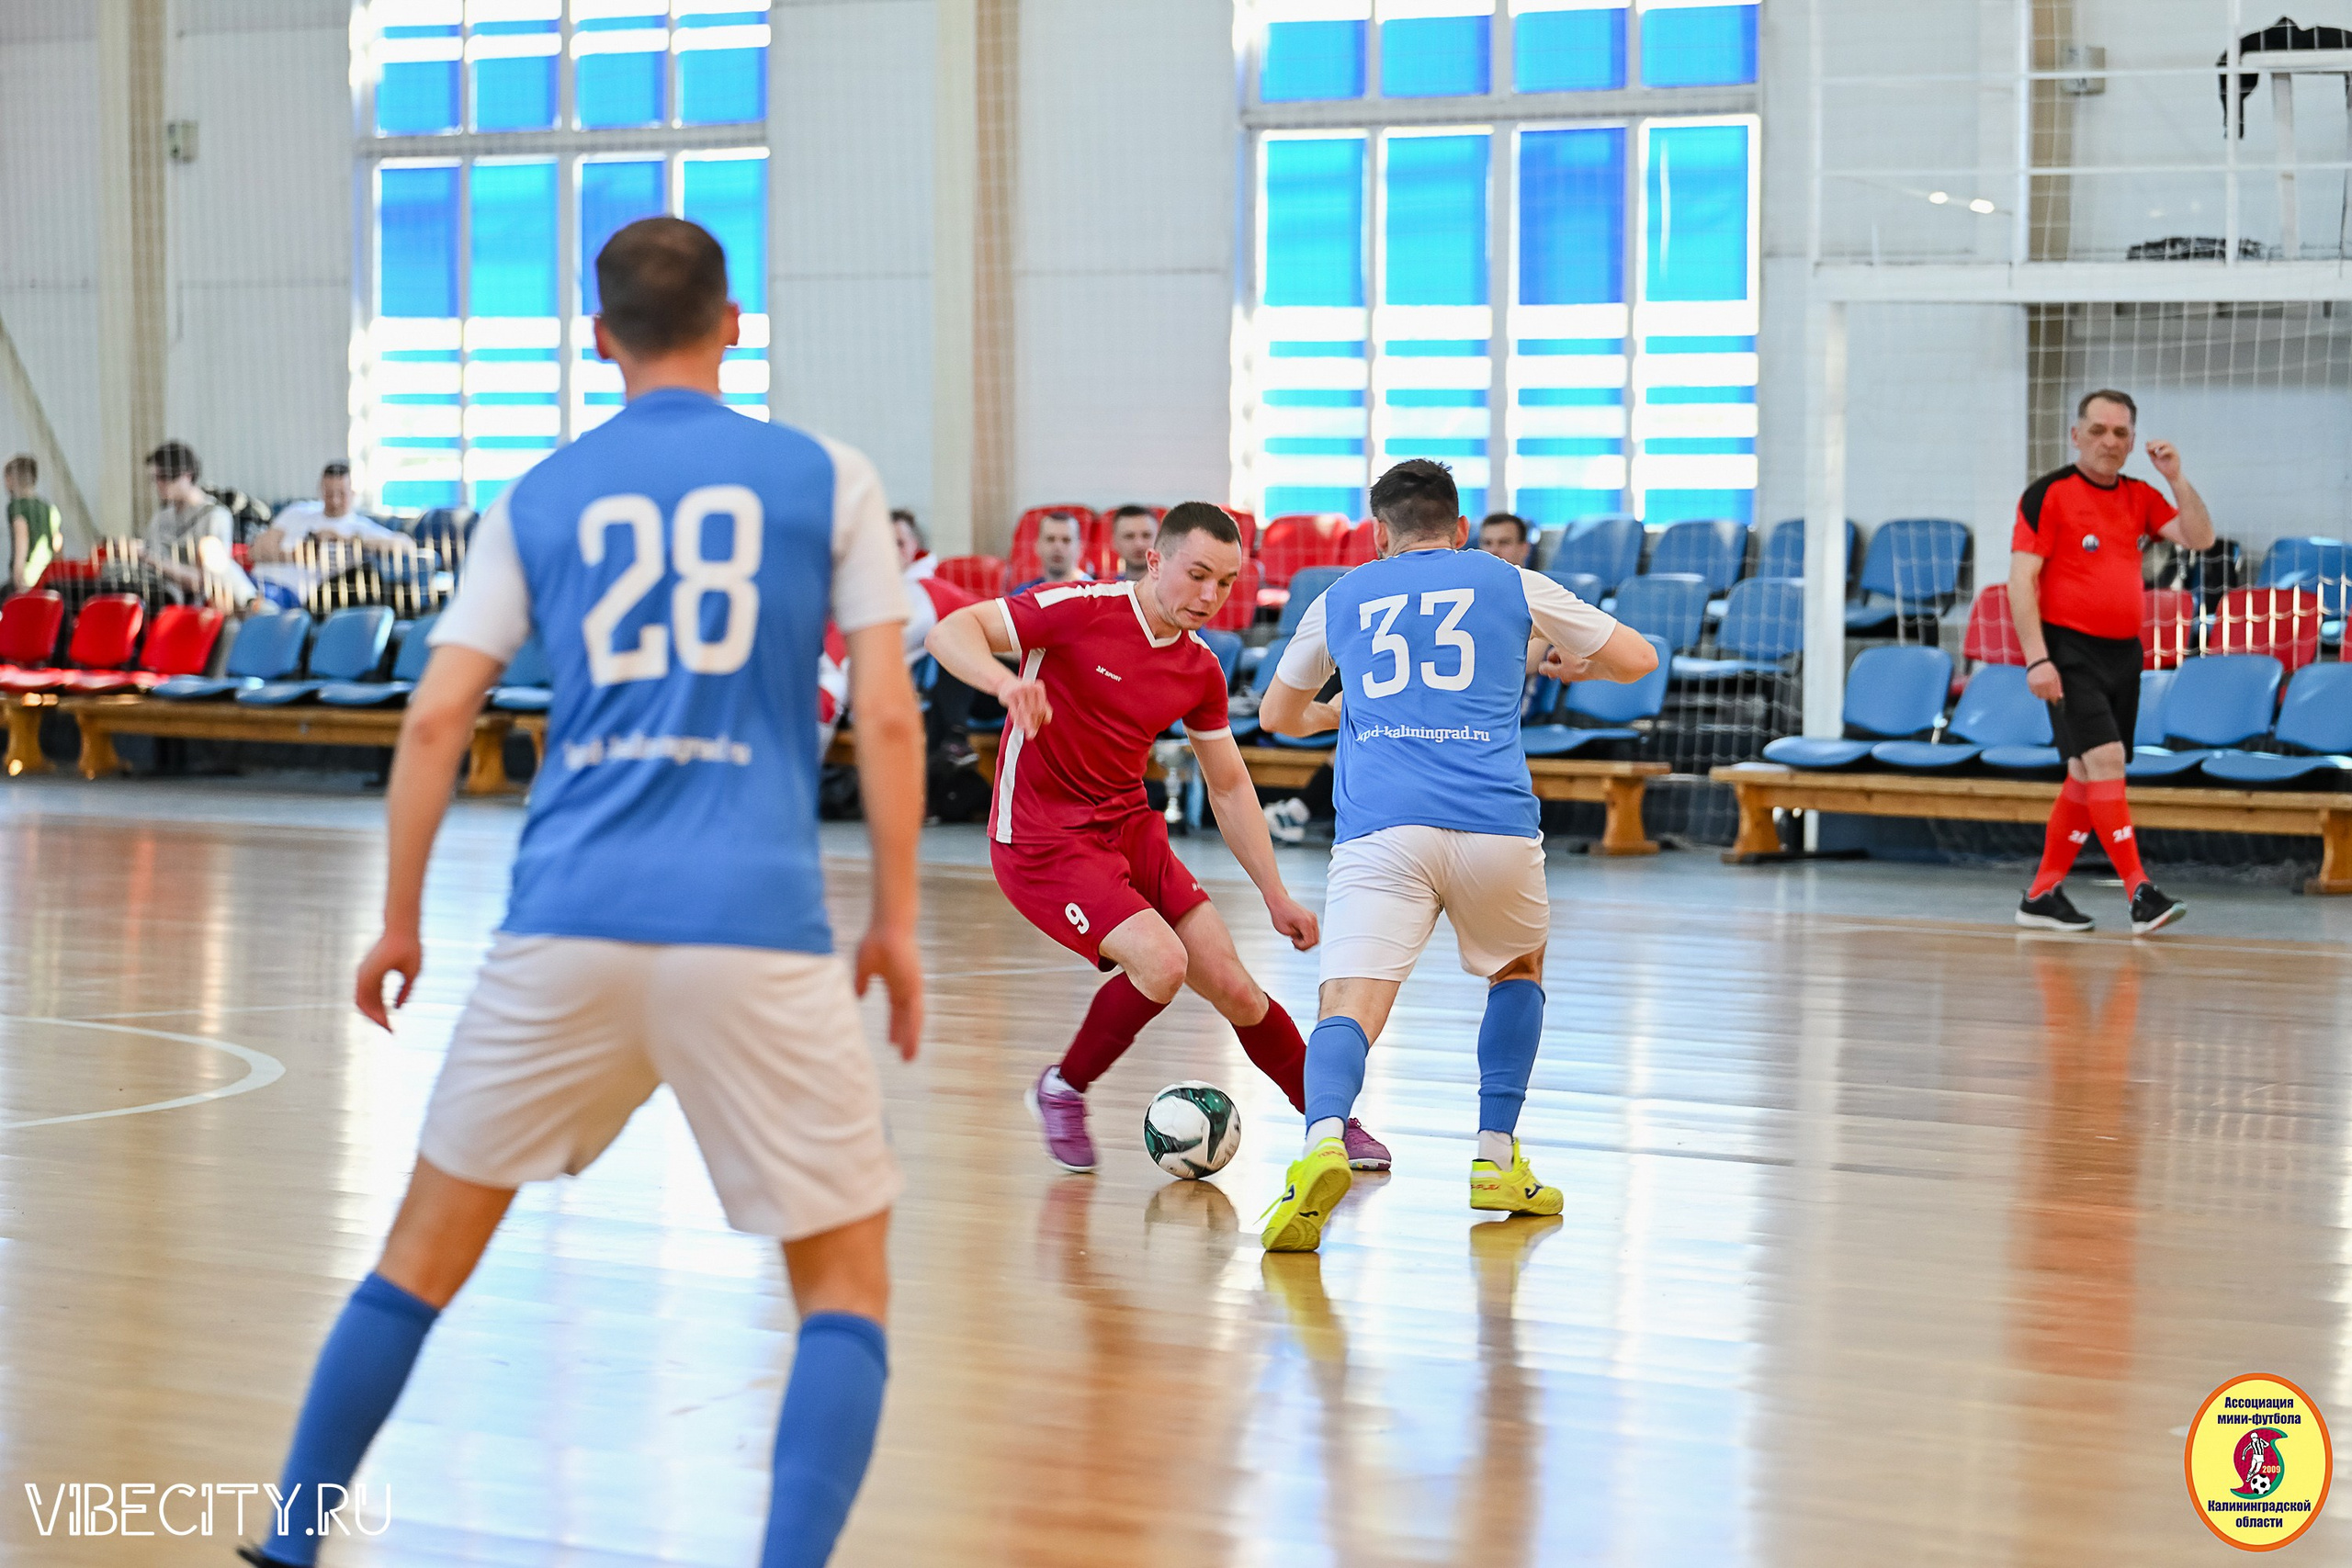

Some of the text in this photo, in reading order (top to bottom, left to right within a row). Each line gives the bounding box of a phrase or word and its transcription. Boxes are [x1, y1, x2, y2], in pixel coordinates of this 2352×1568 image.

[577, 483, 764, 689] 28
[1359, 588, 1475, 699] 33
[1065, 902, 1090, 935] 9
